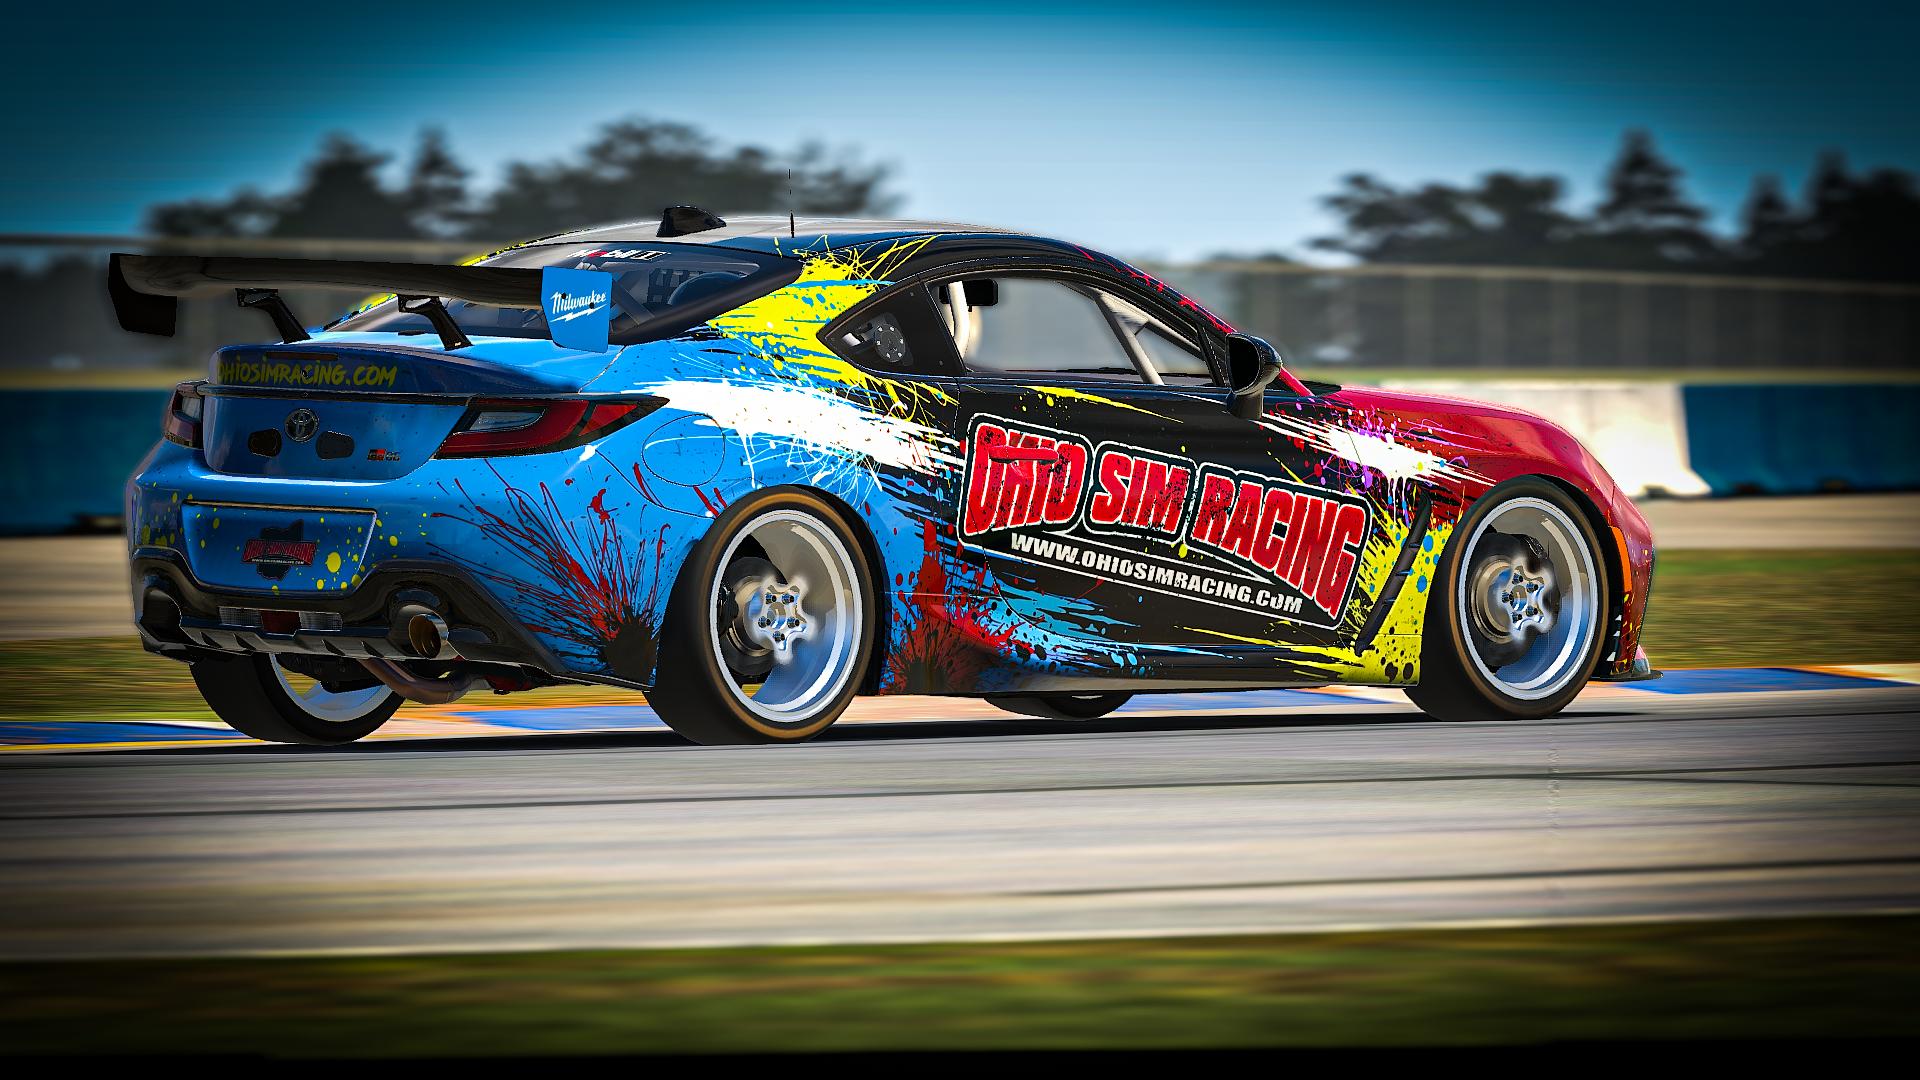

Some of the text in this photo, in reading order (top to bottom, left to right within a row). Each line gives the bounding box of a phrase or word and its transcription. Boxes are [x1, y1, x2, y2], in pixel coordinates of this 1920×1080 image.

[550, 290, 607, 315] Milwaukee
[964, 422, 1368, 618] OHIO SIM RACING
[1011, 532, 1303, 615] WWW.OHIOSIMRACING.COM
